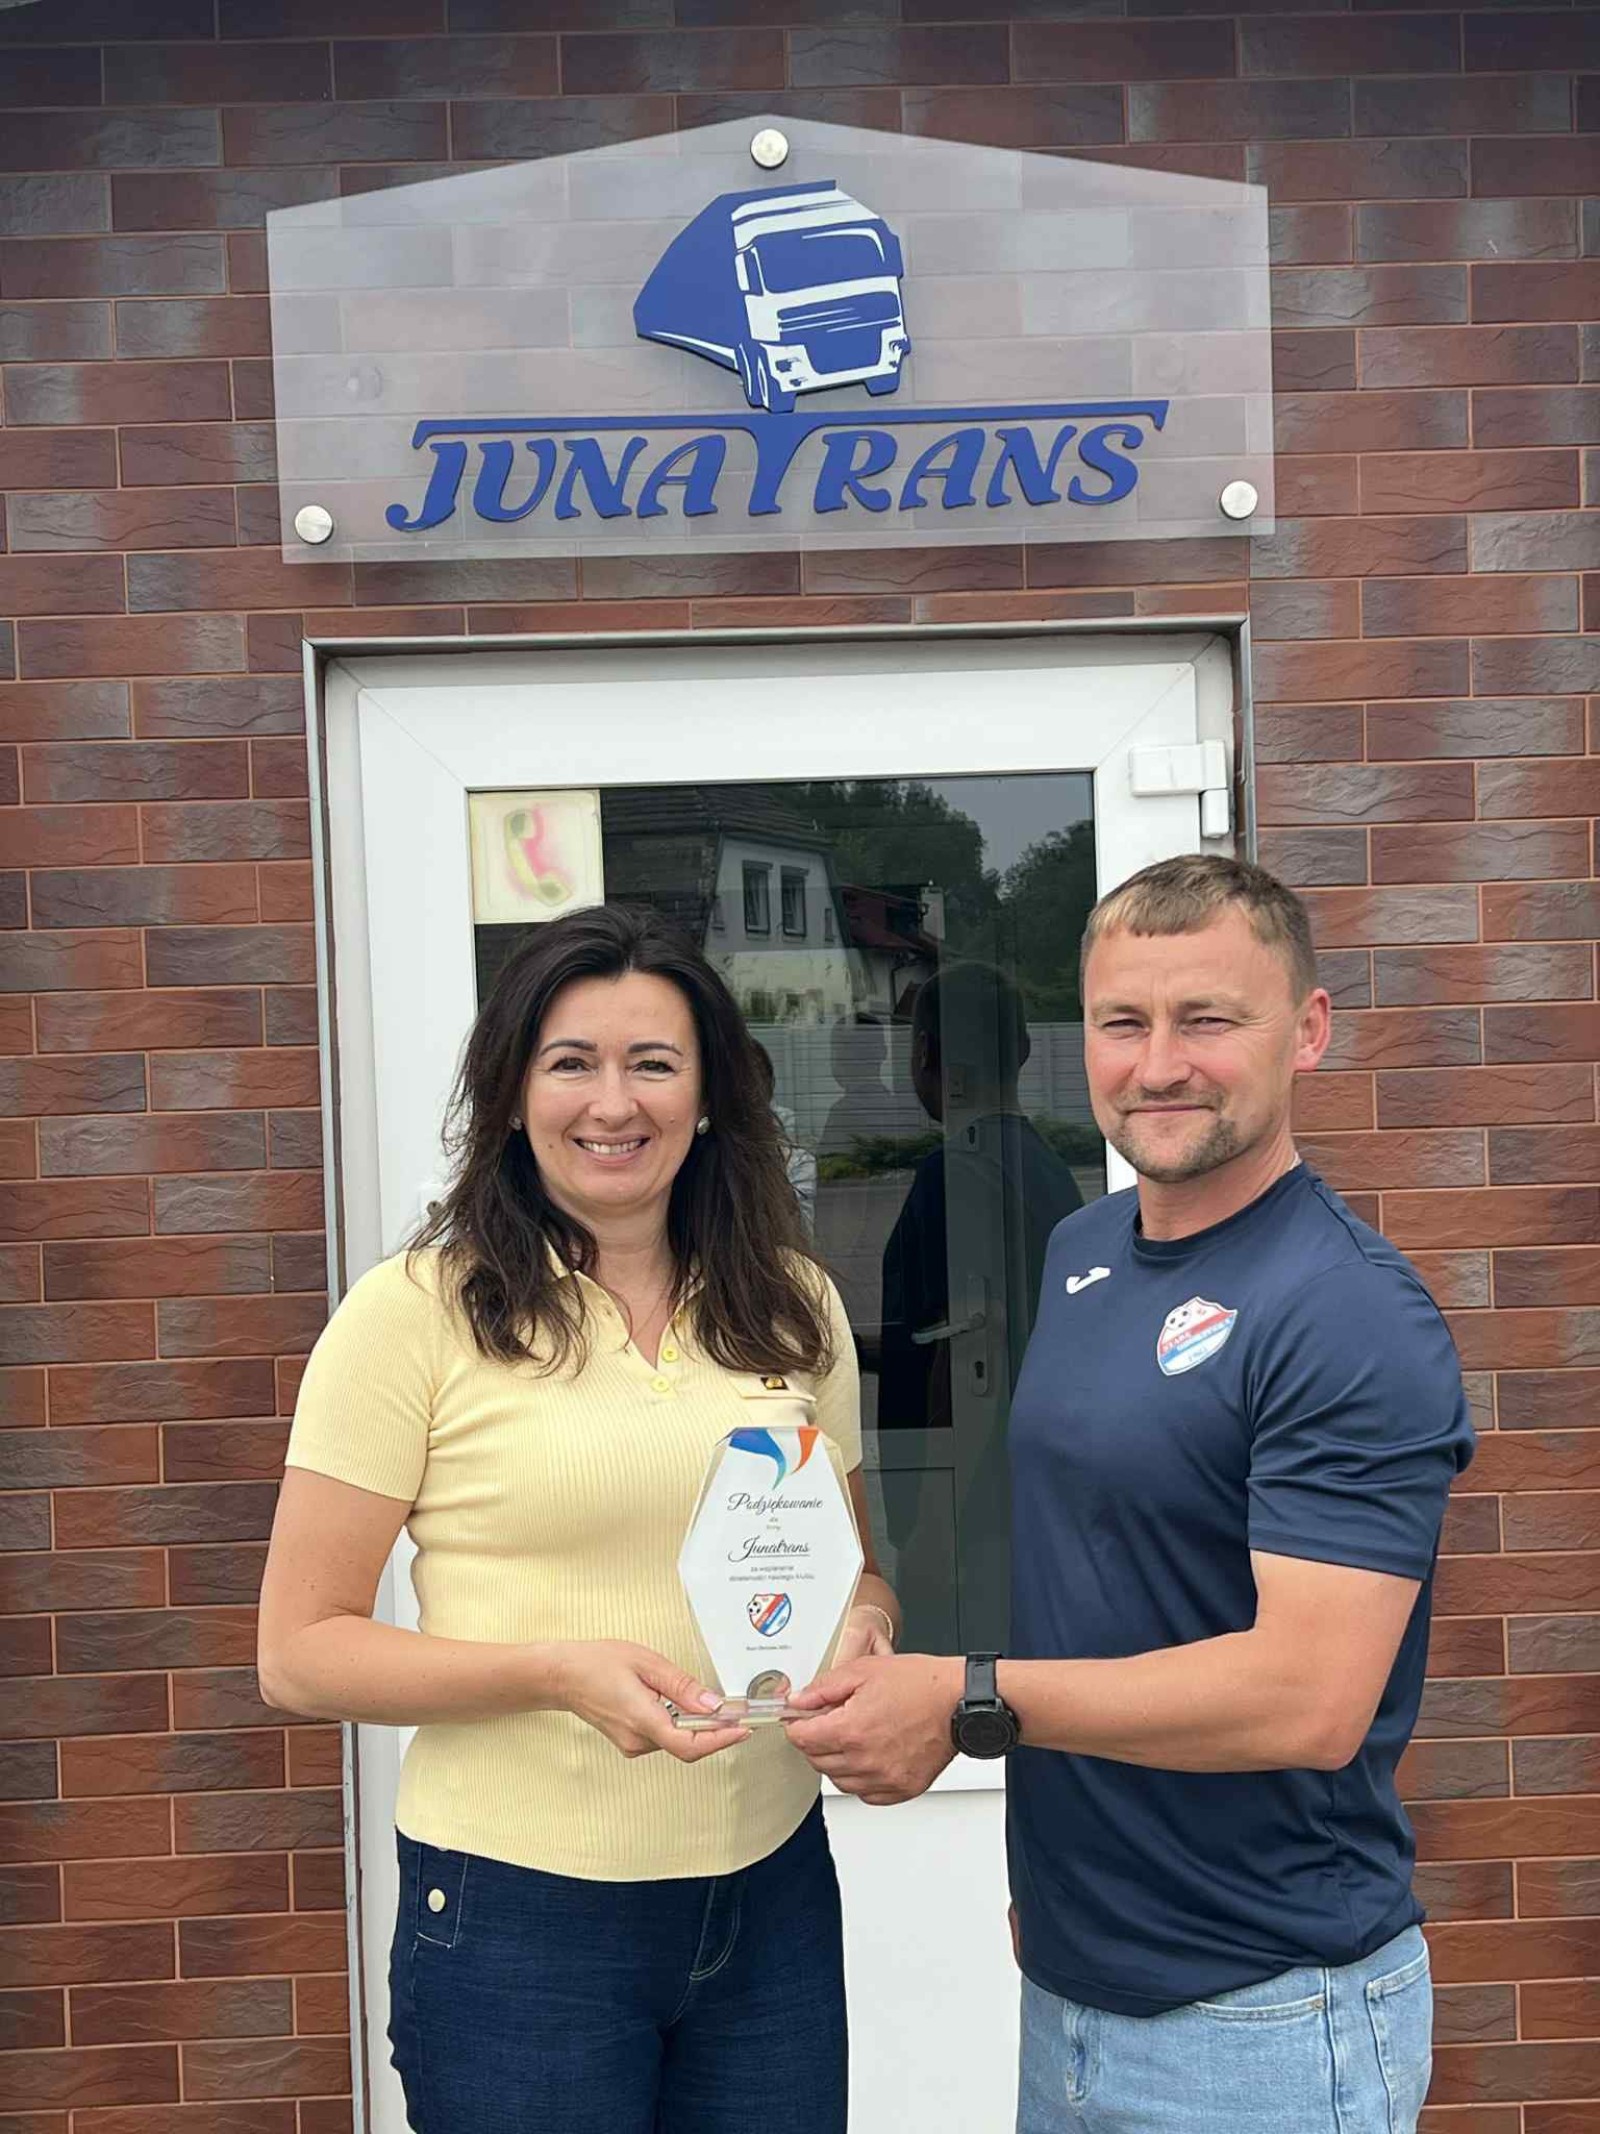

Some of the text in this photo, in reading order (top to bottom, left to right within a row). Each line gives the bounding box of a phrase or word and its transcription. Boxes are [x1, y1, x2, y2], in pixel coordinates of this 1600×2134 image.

[386, 400, 1169, 532] JUNATRANS
[727, 1492, 824, 1515] Podziękowanie
[728, 1535, 812, 1562] Junatrans
